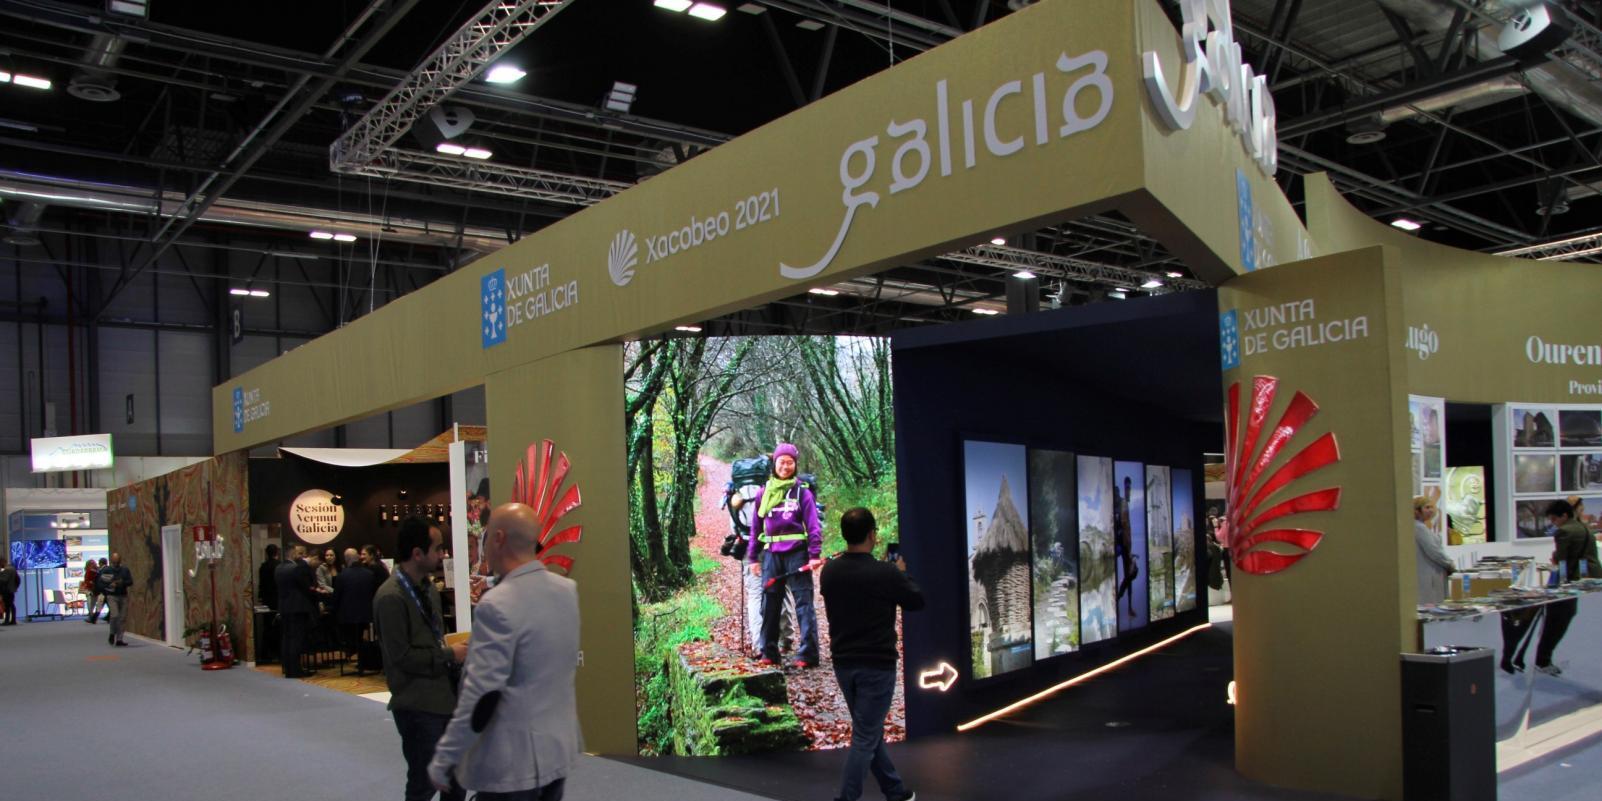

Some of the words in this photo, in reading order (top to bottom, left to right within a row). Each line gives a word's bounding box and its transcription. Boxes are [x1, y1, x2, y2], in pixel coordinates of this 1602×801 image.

[779, 49, 1114, 280] galicia
[645, 211, 730, 264] Xacobeo
[735, 187, 780, 230] 2021
[506, 263, 550, 301] XUNTA
[506, 302, 523, 328] DE
[525, 280, 578, 320] GALICIA
[1244, 299, 1315, 331] XUNTA
[1244, 332, 1268, 356] DE
[1272, 316, 1368, 350] GALICIA
[1405, 323, 1439, 360] ugo
[1526, 335, 1602, 365] Ouren
[296, 522, 338, 533] Galicia
